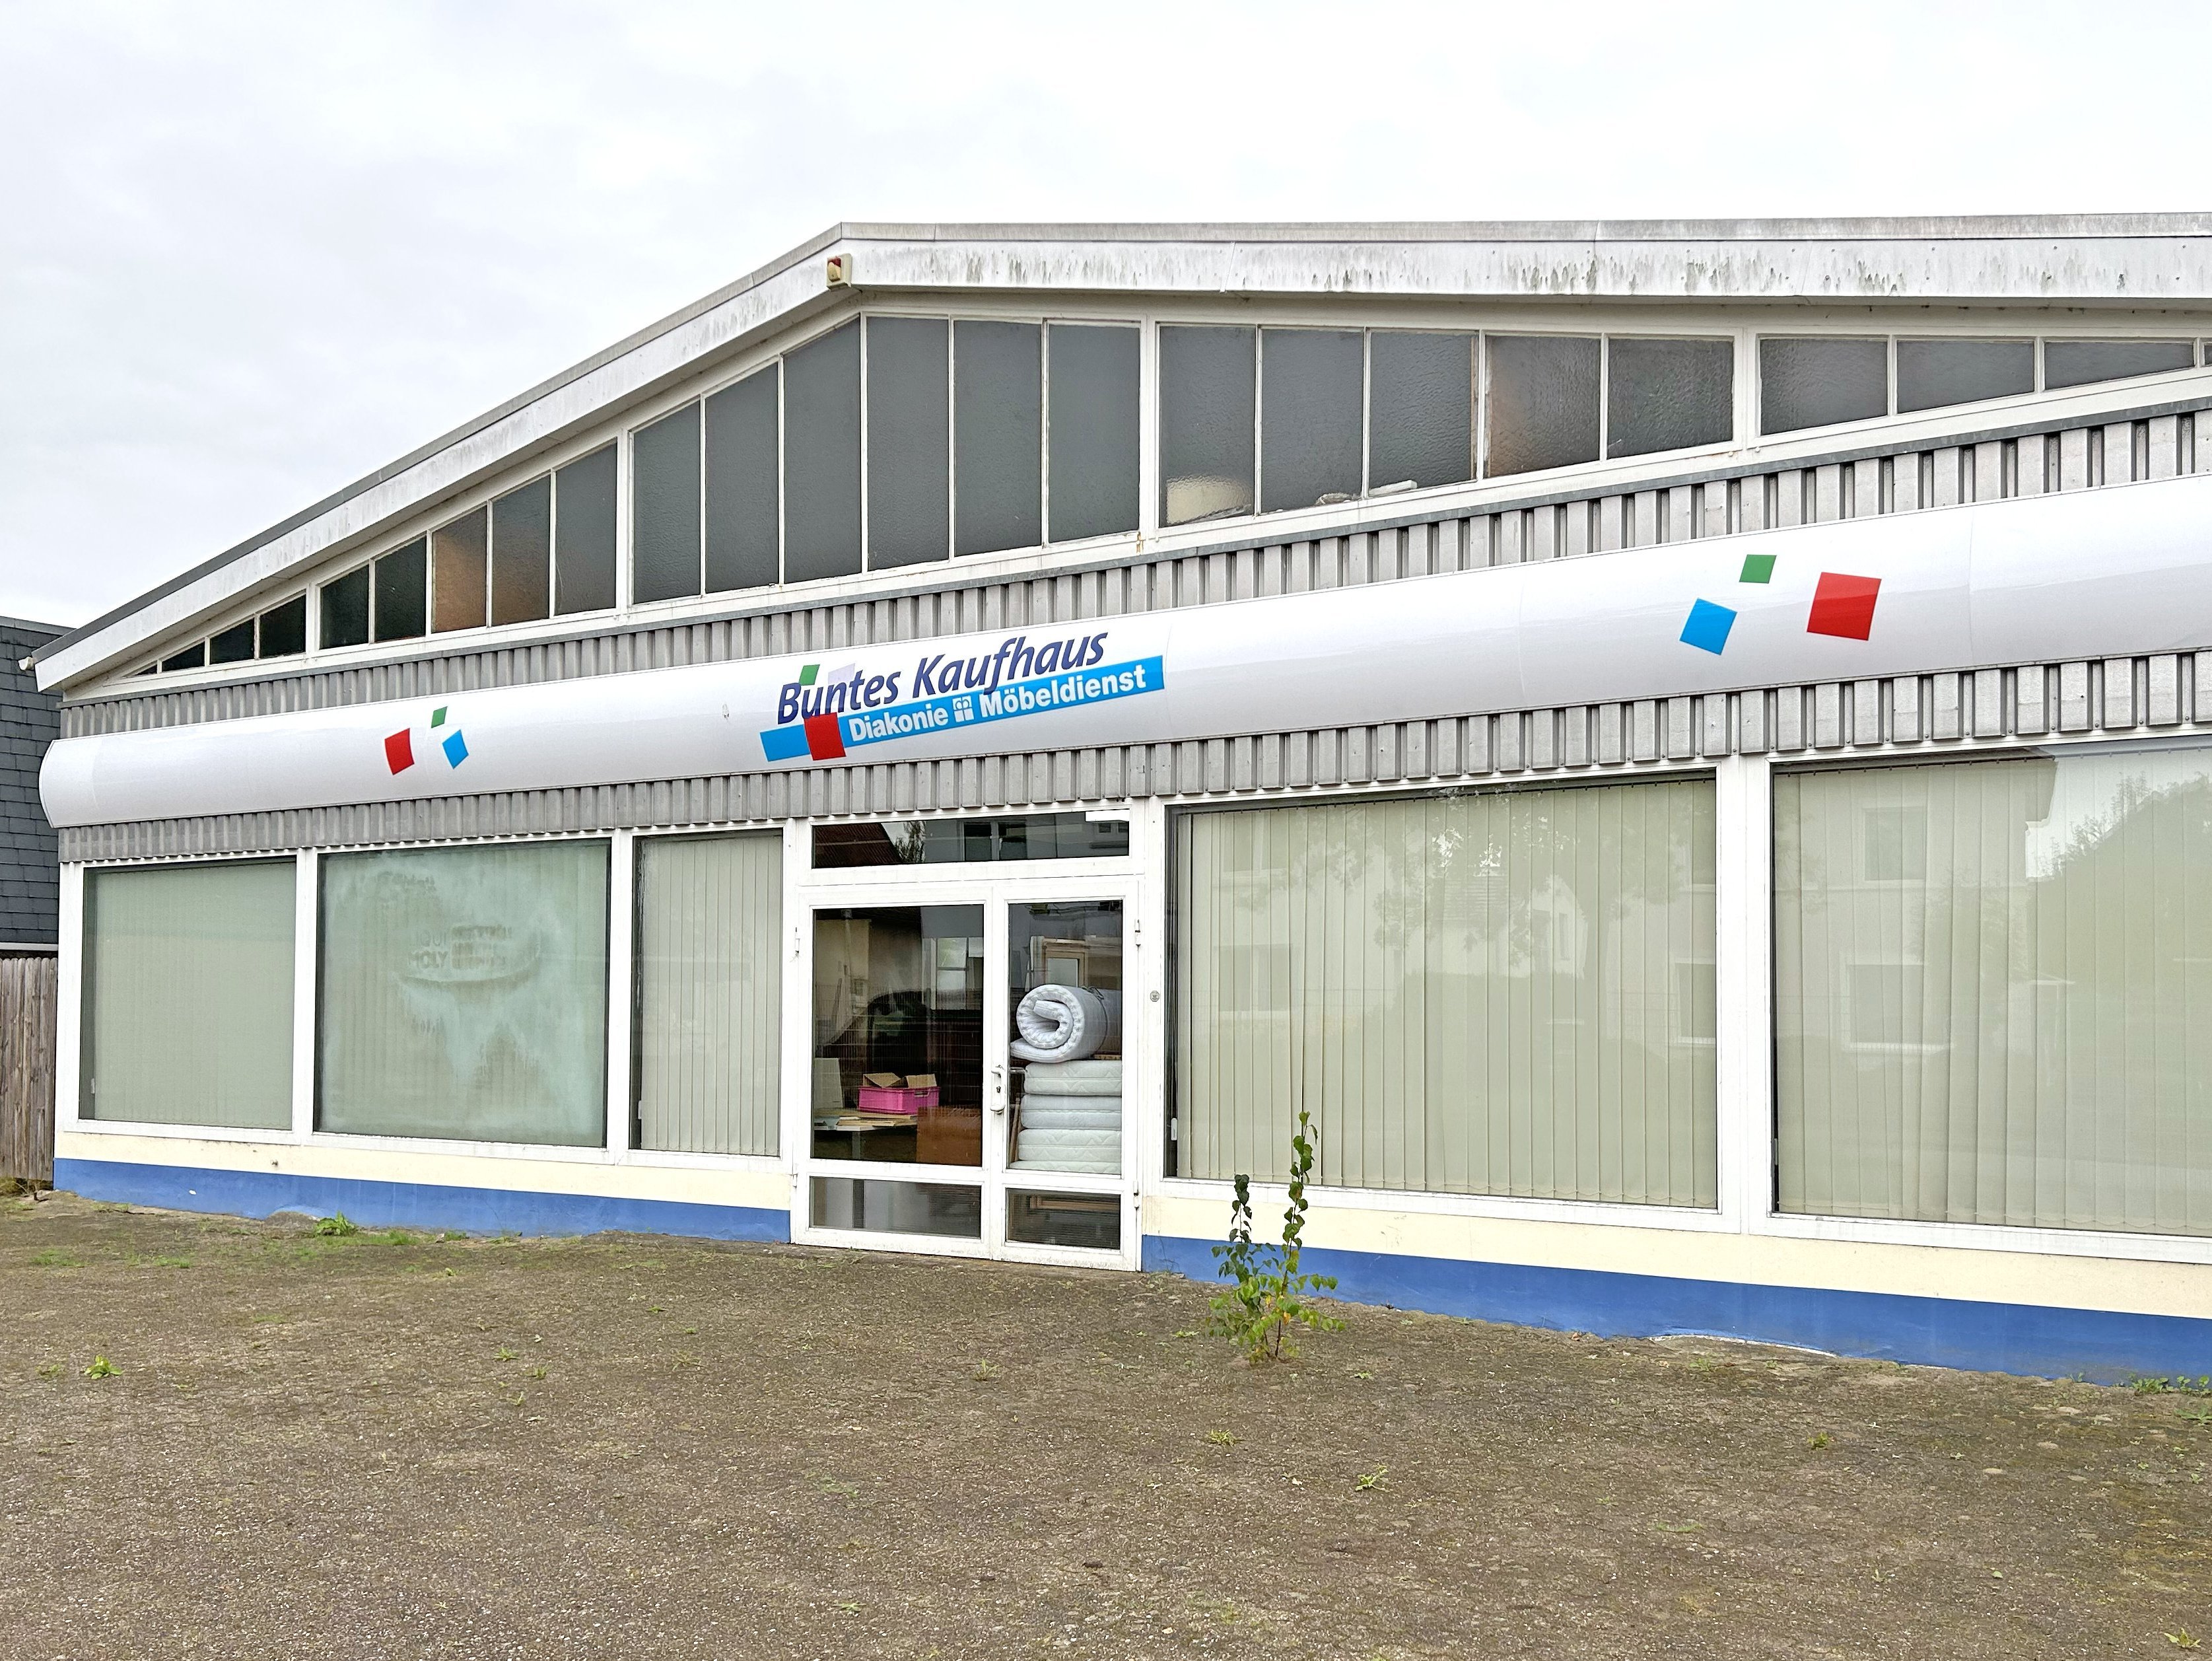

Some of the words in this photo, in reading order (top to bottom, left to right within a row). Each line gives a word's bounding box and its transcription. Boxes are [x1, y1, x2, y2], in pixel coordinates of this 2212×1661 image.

[778, 670, 901, 724] Buntes
[913, 632, 1108, 698] Kaufhaus
[849, 703, 948, 743] Diakonie
[980, 664, 1146, 719] Möbeldienst
[410, 931, 448, 947] IQUI
